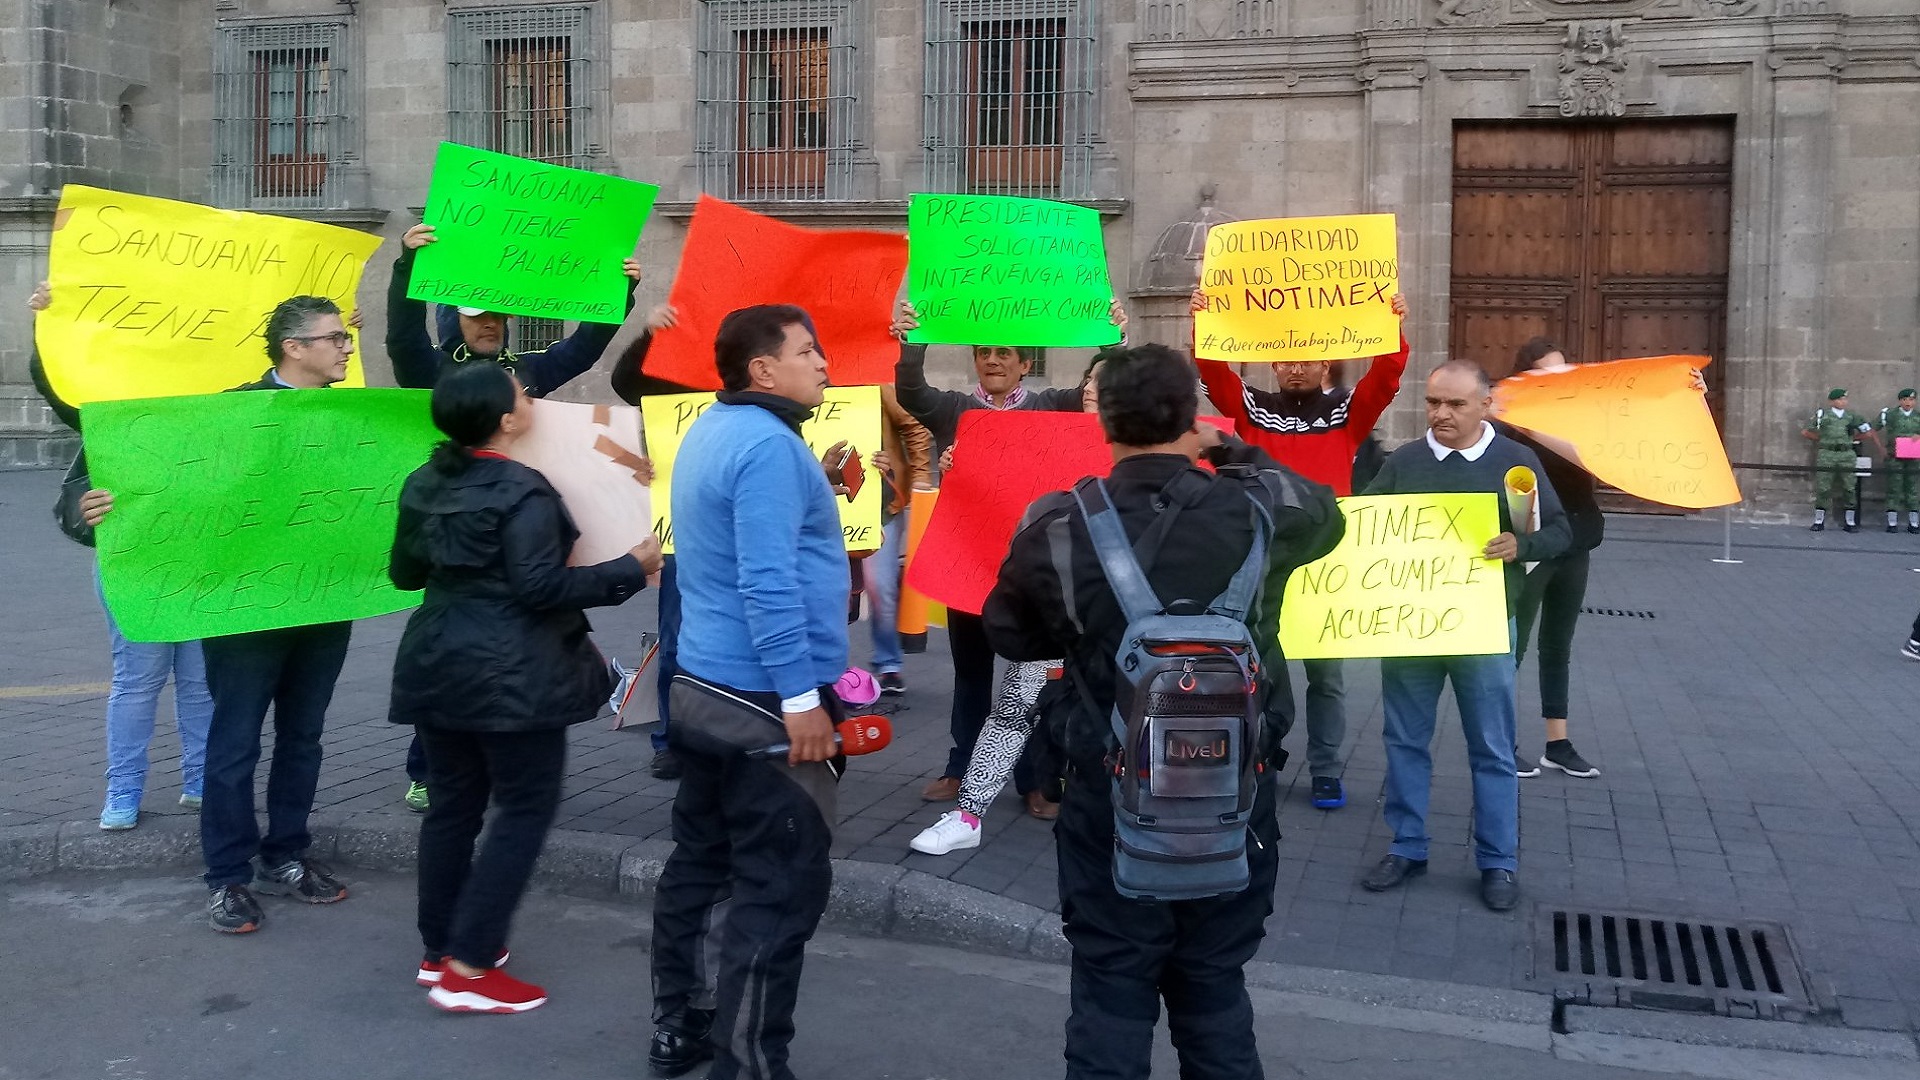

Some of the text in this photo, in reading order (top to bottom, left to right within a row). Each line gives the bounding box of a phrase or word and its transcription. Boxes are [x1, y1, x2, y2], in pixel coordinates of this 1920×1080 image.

[461, 160, 607, 209] SANJUANA
[439, 199, 580, 239] NO TIENE
[926, 198, 1079, 229] PRESIDENTE
[78, 205, 355, 300] SANJUANA NO
[955, 234, 1100, 260] SOLICITAMOS
[1210, 227, 1359, 257] SOLIDARIDAD
[497, 244, 601, 283] PALABRA
[922, 263, 1064, 293] INTERVENGA
[1204, 268, 1234, 288] CON
[1242, 266, 1273, 285] LOS
[74, 285, 229, 341] TIENE
[415, 279, 618, 316] #DESPEDIDOSDENOTIMEX
[915, 297, 959, 321] QUE
[966, 296, 1052, 324] NOTIMEX
[1205, 281, 1390, 313] EN NOTIMEX
[1350, 503, 1464, 547] TIMEX
[137, 552, 396, 628] PRESUPUE
[1302, 555, 1485, 595] NO CUMPLE
[1318, 604, 1463, 643] ACUERDO
